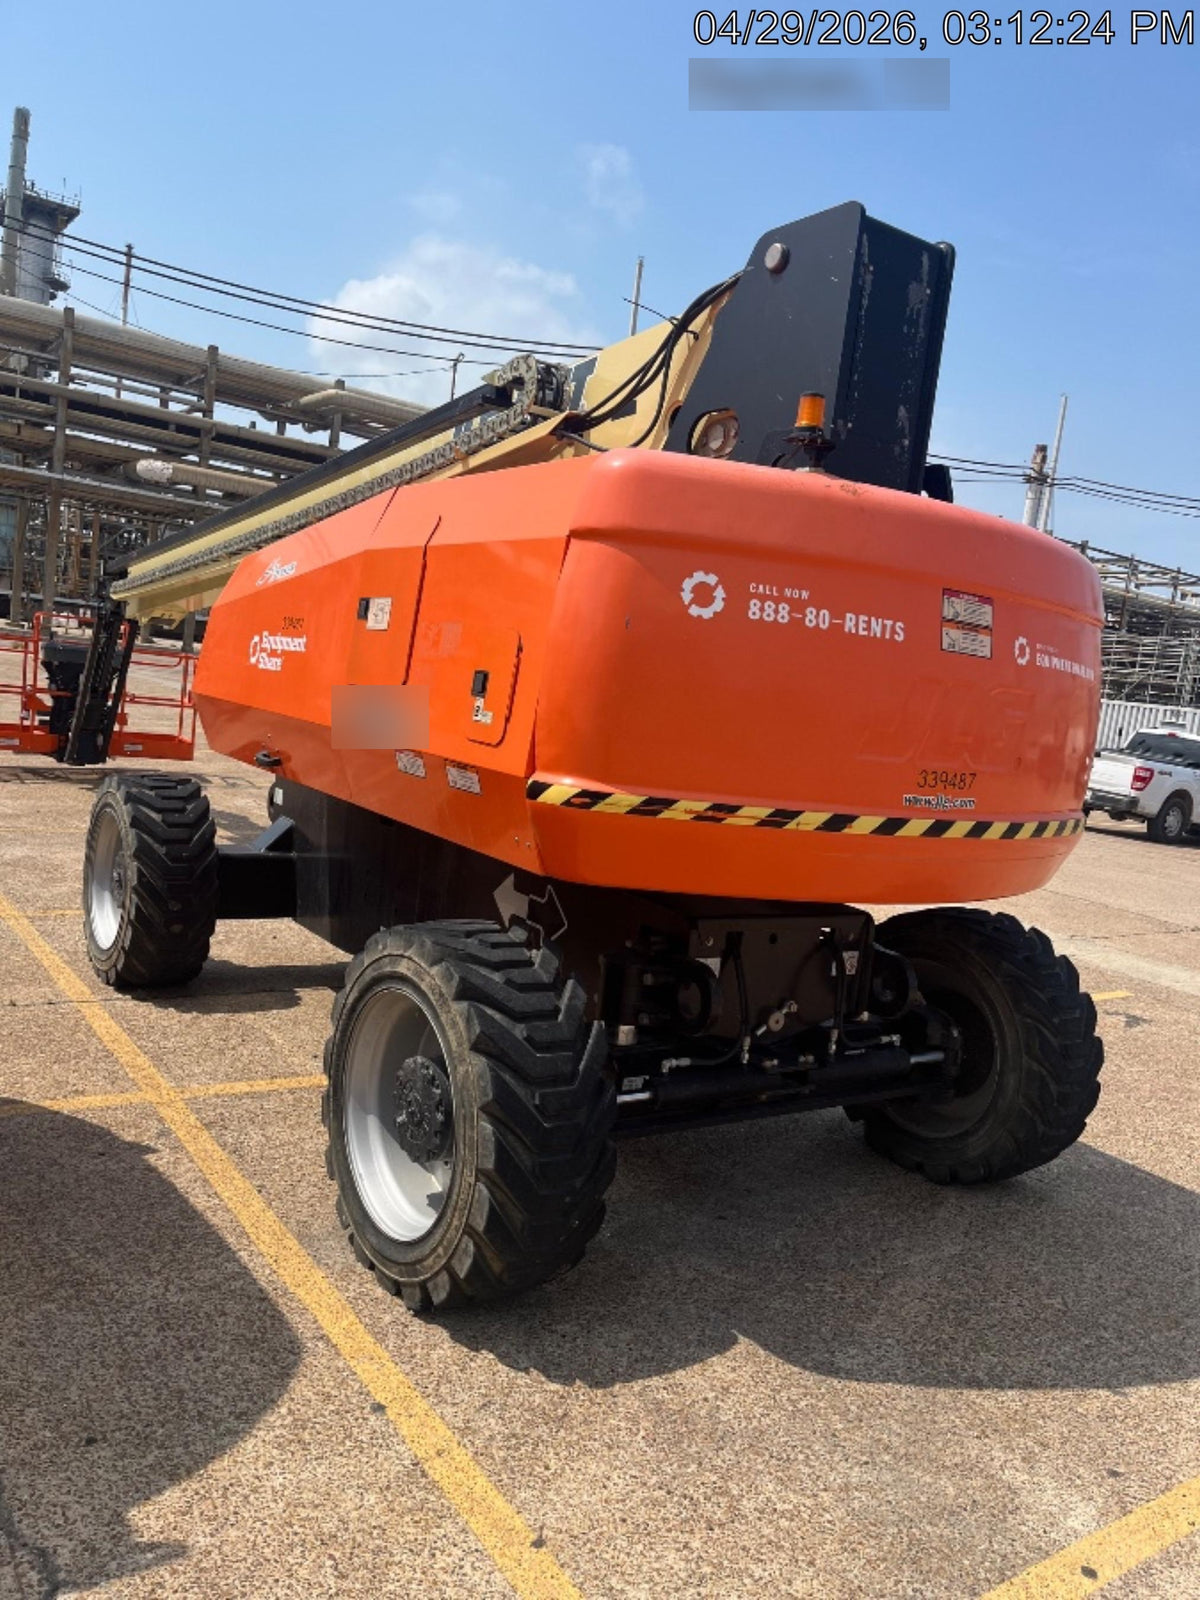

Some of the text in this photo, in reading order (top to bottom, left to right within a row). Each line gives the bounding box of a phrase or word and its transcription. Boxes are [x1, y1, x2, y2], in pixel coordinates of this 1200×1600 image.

[749, 582, 810, 600] CALL NOW
[748, 598, 906, 642] 888-80-RENTS
[917, 769, 977, 790] 339487
